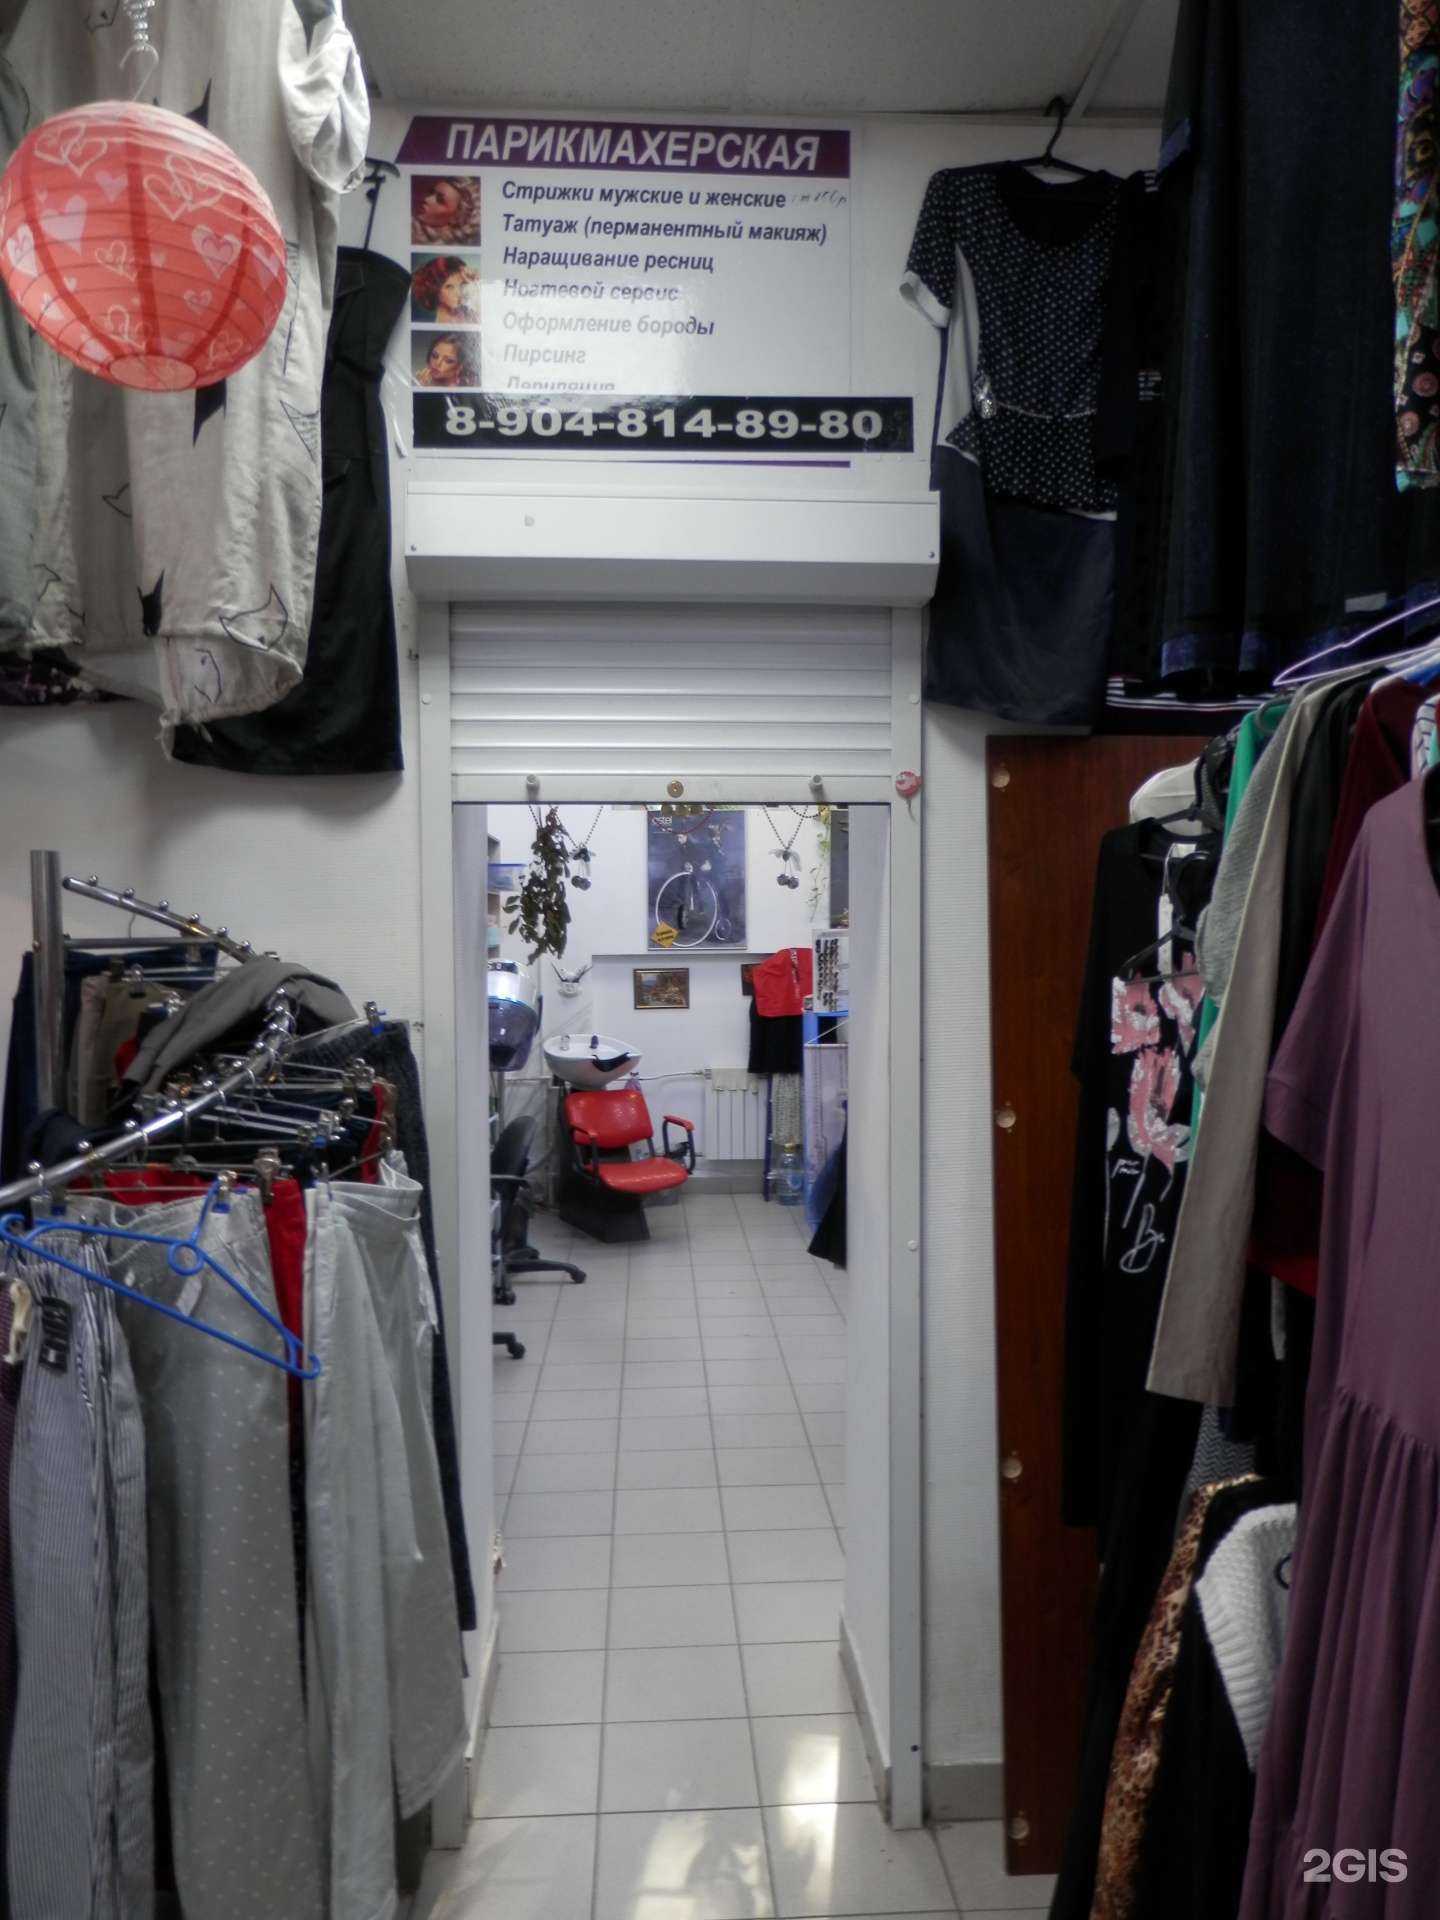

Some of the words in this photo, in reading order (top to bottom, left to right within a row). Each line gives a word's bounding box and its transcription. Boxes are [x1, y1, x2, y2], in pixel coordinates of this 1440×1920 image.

[446, 123, 820, 171] ПАРИКМАХЕРСКАЯ
[502, 181, 594, 205] Стрижки
[599, 187, 684, 207] мужские
[689, 191, 701, 205] и
[705, 191, 787, 208] женские
[503, 214, 578, 237] Татуаж
[584, 216, 743, 240] (перманентный
[749, 223, 828, 246] макияж)
[503, 246, 639, 270] Наращивание
[644, 254, 714, 274] ресниц
[503, 278, 605, 299] Ногтевой
[610, 285, 679, 304] сервис
[503, 311, 632, 335] Оформление
[637, 315, 715, 338] бороды
[503, 344, 587, 367] Пирсинг
[445, 406, 884, 440] 8-904-814-89-80
